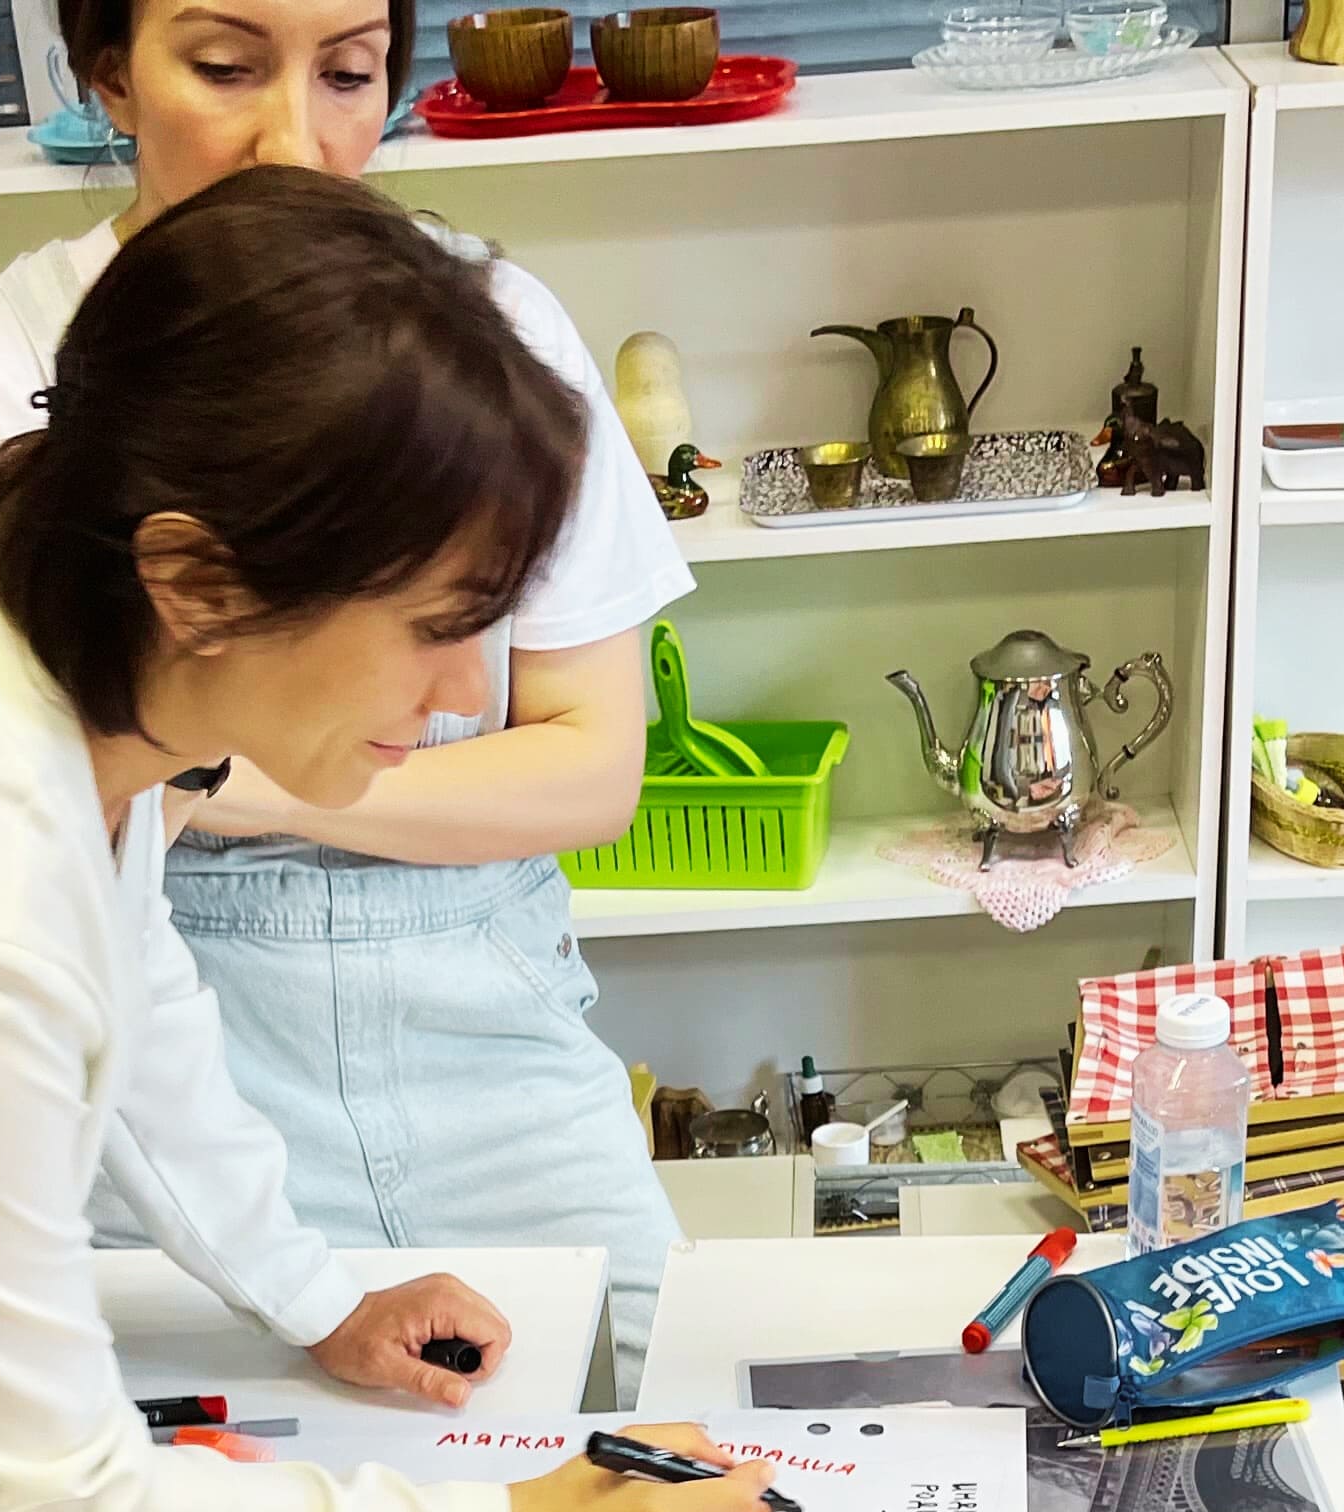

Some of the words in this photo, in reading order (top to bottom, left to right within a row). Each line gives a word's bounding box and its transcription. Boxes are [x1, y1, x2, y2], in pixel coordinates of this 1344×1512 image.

[1149, 1236, 1284, 1309] INSIDE
[1195, 1259, 1310, 1314] LOVE
[436, 1431, 566, 1450] МЯГКАЯ
[716, 1442, 857, 1476] ПТАЦИЯ
